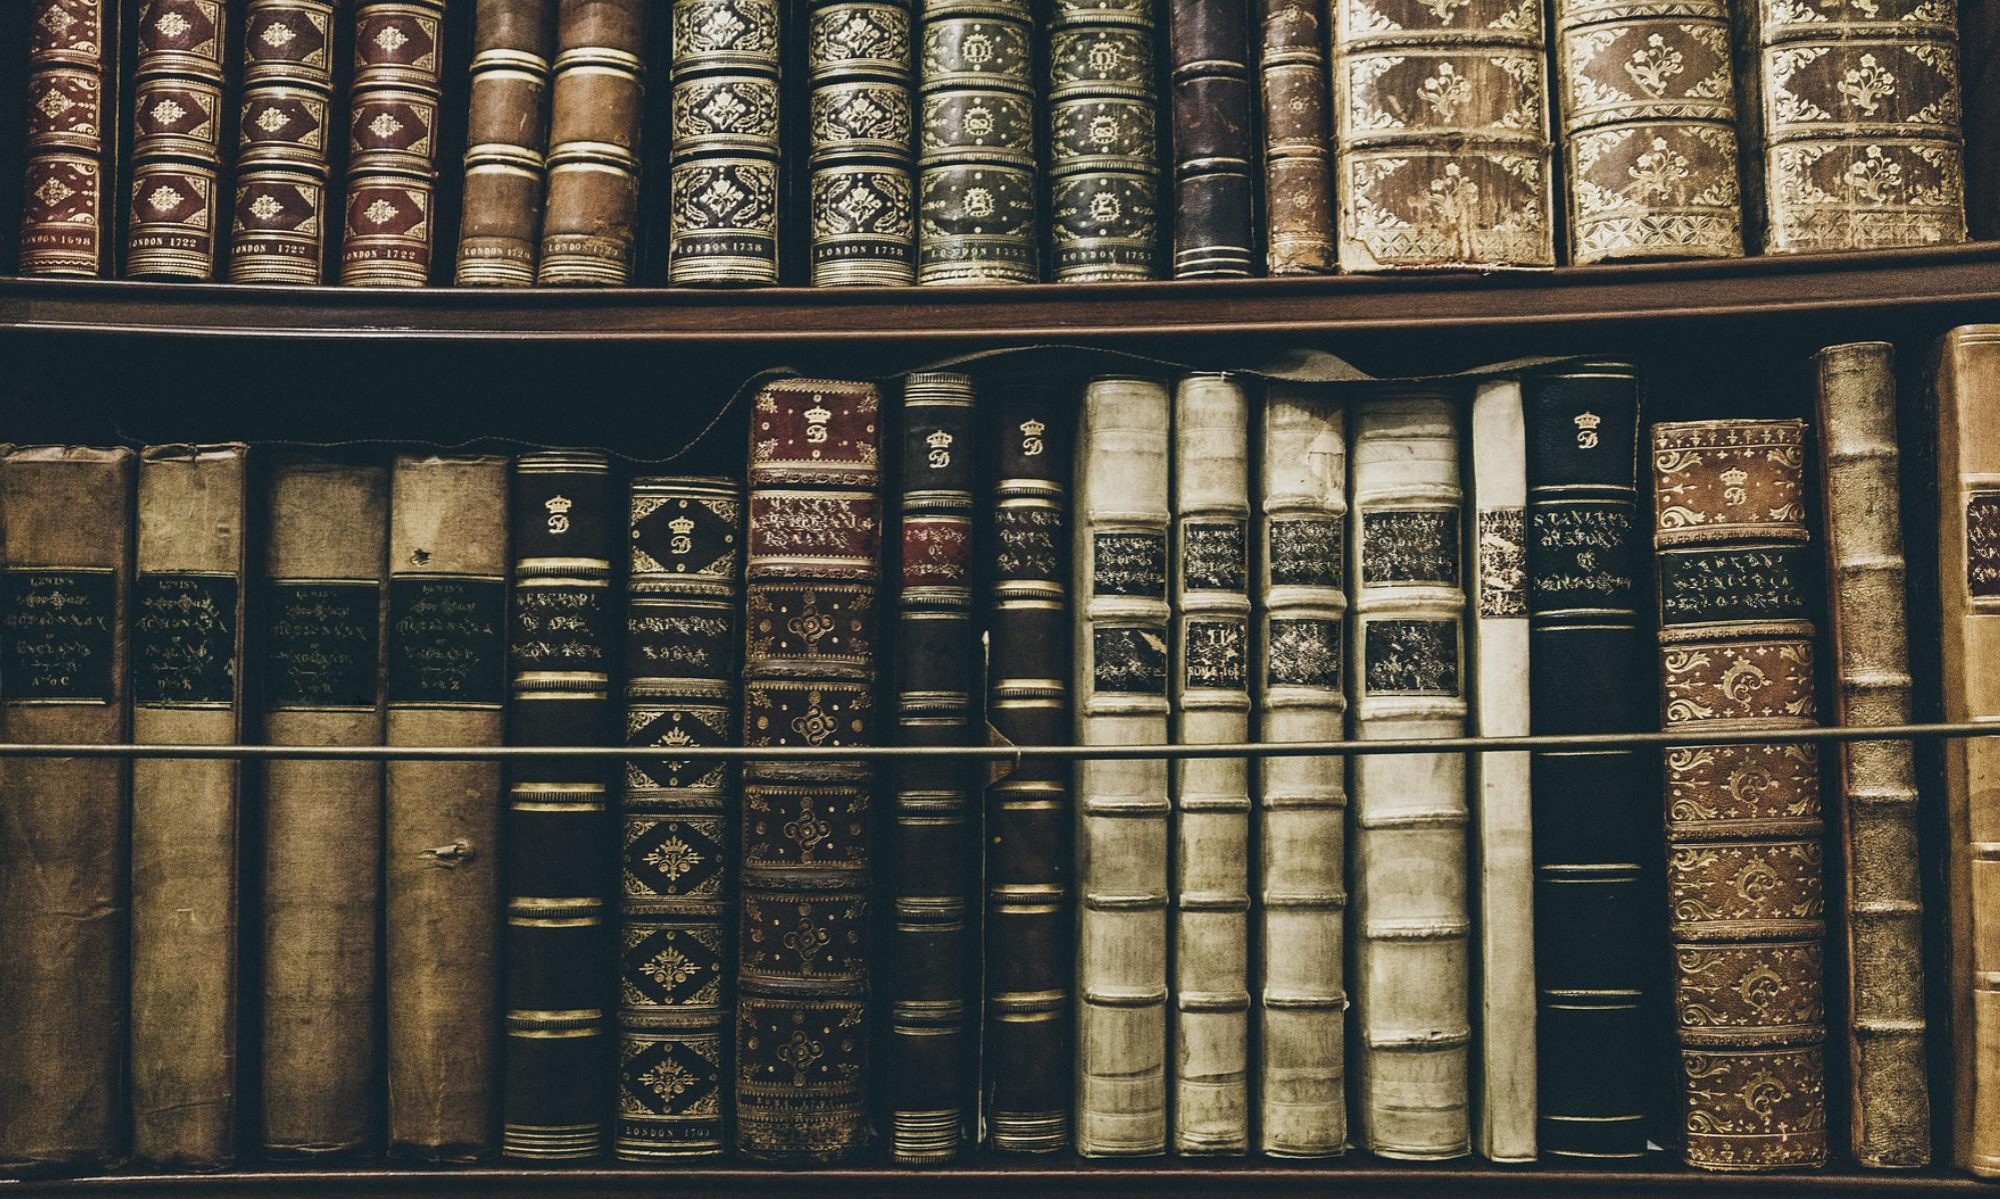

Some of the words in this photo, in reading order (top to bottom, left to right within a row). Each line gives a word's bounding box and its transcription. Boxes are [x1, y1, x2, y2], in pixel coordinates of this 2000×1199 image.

[61, 235, 91, 246] 1698
[169, 237, 198, 248] 1722
[278, 244, 306, 254] 1722
[464, 246, 503, 257] LONDON
[548, 243, 587, 254] LONDON
[678, 243, 727, 255] LONDON
[732, 242, 763, 253] 1738
[818, 246, 867, 259] LONDON
[874, 246, 905, 257] 1738
[931, 247, 988, 260] LONDON
[387, 249, 416, 260] 1722
[1062, 250, 1114, 262] LONDON
[625, 1125, 673, 1138] LONDON
